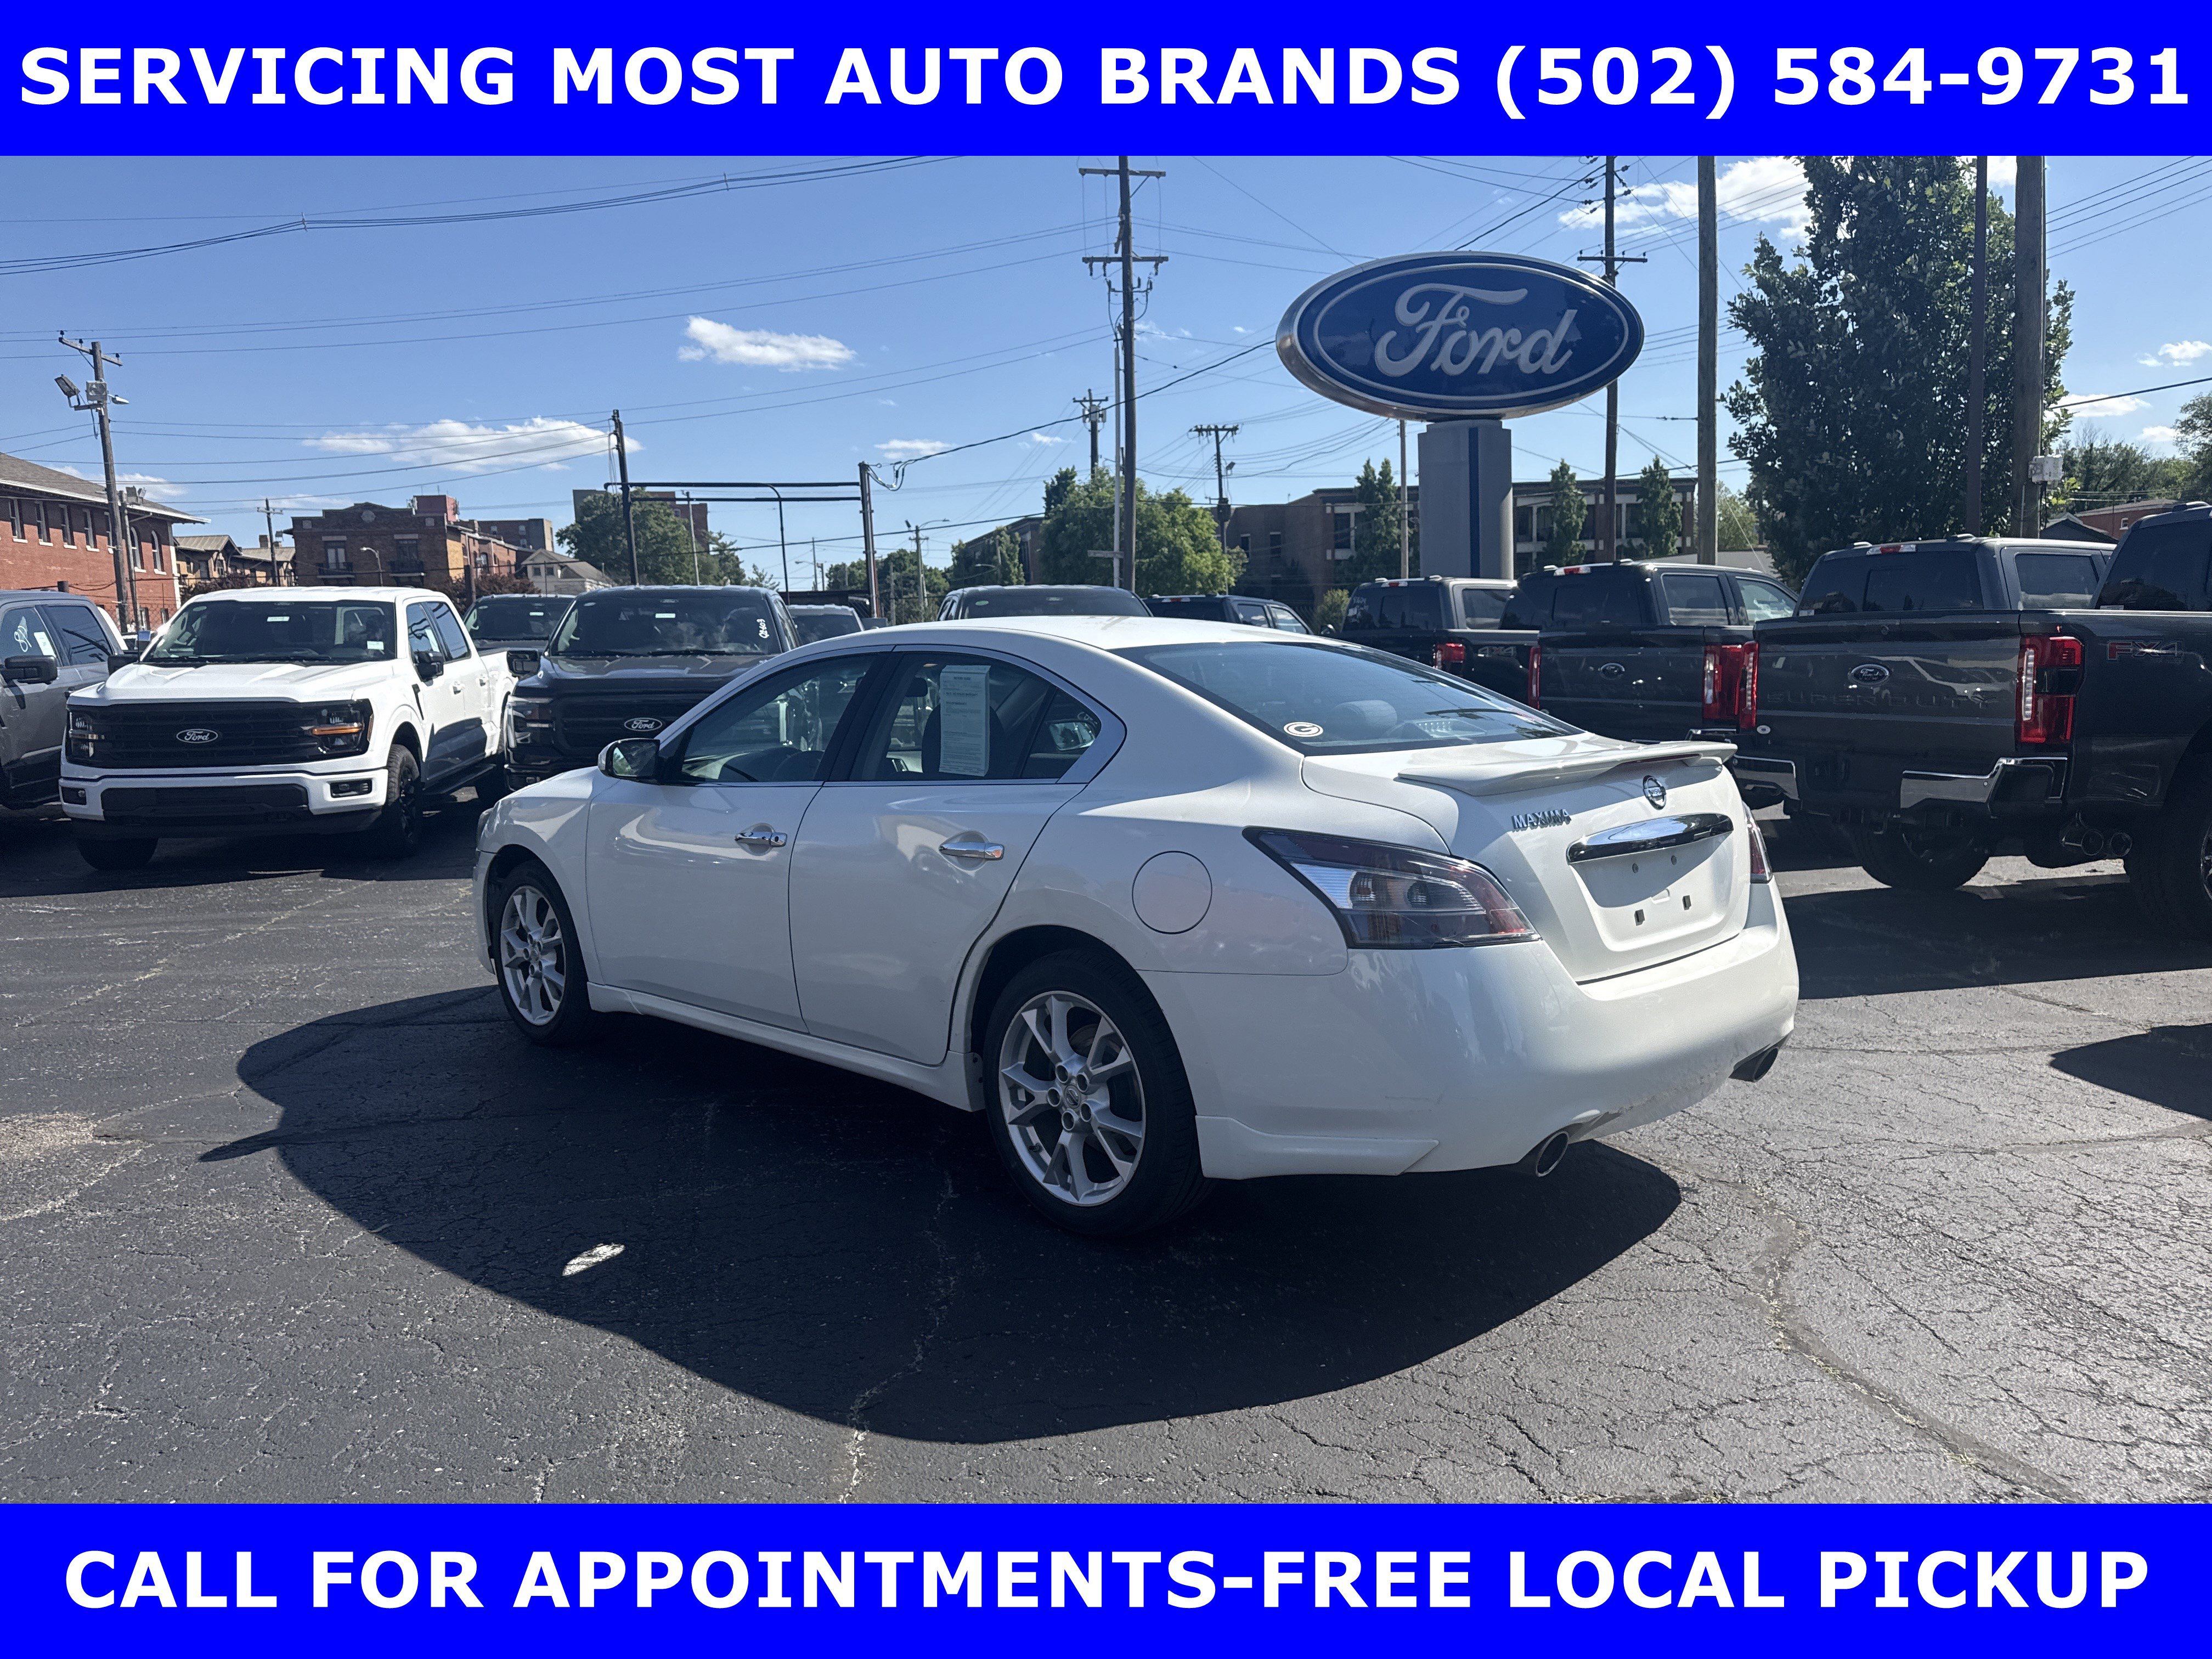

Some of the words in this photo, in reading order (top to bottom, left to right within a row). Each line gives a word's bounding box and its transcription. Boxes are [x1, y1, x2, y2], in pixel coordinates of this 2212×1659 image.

[1375, 283, 1578, 376] Ford
[2108, 639, 2183, 661] FX4
[631, 720, 655, 729] Ford
[184, 731, 210, 741] Ford
[1511, 809, 1571, 828] MAXIMA
